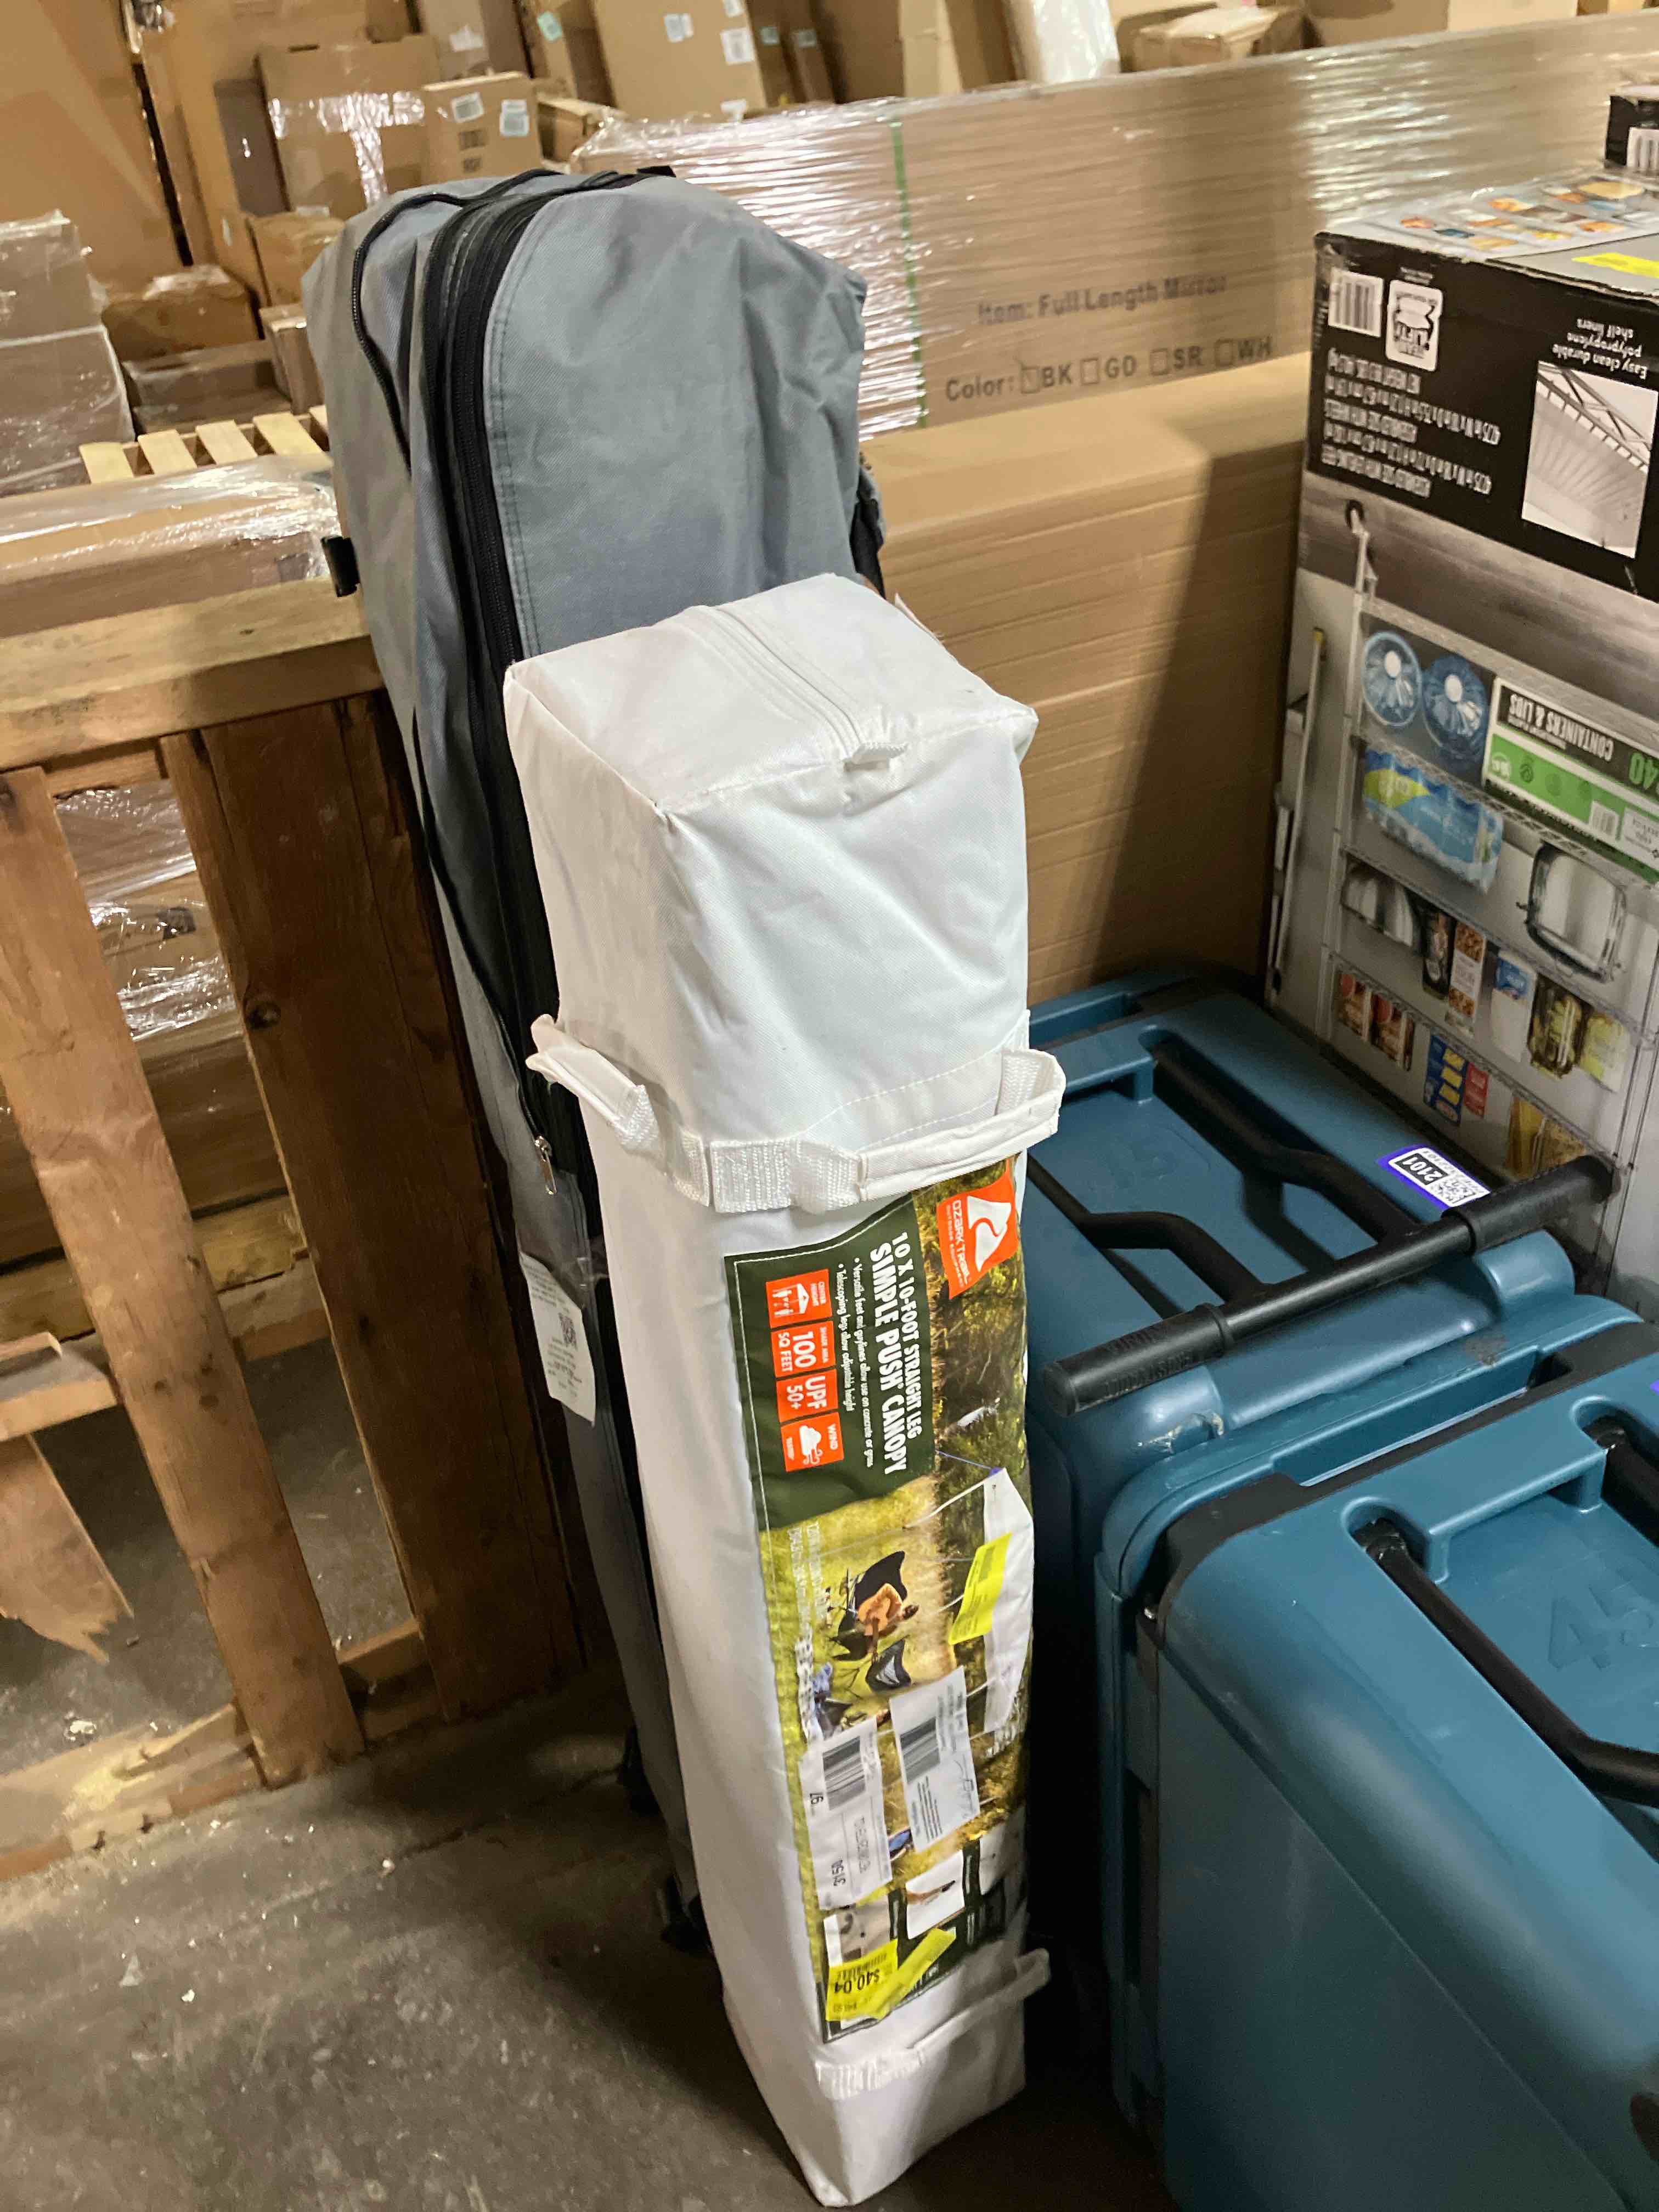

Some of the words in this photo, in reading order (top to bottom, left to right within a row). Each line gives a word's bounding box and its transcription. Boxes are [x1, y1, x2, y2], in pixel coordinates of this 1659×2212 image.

[1039, 293, 1080, 317] Full
[1084, 281, 1158, 311] Length
[1606, 325, 1633, 341] shelf
[946, 375, 1014, 401] Color:
[1042, 363, 1073, 388] BK
[1173, 345, 1204, 370] SR
[1593, 354, 1620, 371] clean
[1622, 358, 1647, 380] Easy
[1509, 693, 1534, 724] LIDS
[1545, 711, 1614, 761] CONTAINERS
[1402, 1156, 1443, 1182] 2101
[952, 1200, 966, 1245] OZARK
[892, 1232, 911, 1258] 10
[853, 1263, 865, 1298] Versatile
[898, 1259, 914, 1276] X
[835, 1269, 848, 1315] Telescoping
[870, 1242, 899, 1327] SIMPLE
[855, 1297, 866, 1315] feet
[899, 1277, 919, 1342] 10-FOOT
[838, 1314, 851, 1331] legs
[856, 1315, 867, 1329] and
[778, 1332, 791, 1348] SQ
[792, 1331, 817, 1368] 100
[854, 1329, 868, 1362] guylines
[780, 1350, 793, 1372] FEET
[859, 1363, 871, 1381] allow
[860, 1383, 869, 1396] use
[904, 1344, 922, 1412] STRAIGHT
[786, 1384, 804, 1409] 50+
[805, 1375, 827, 1409] UPF
[843, 1388, 856, 1412] height
[861, 1397, 870, 1407] on
[862, 1408, 873, 1438] concrete
[882, 1394, 906, 1475] CANOPY
[906, 1411, 922, 1439] LEG
[827, 1423, 838, 1450] WIND
[865, 1438, 873, 1448] or
